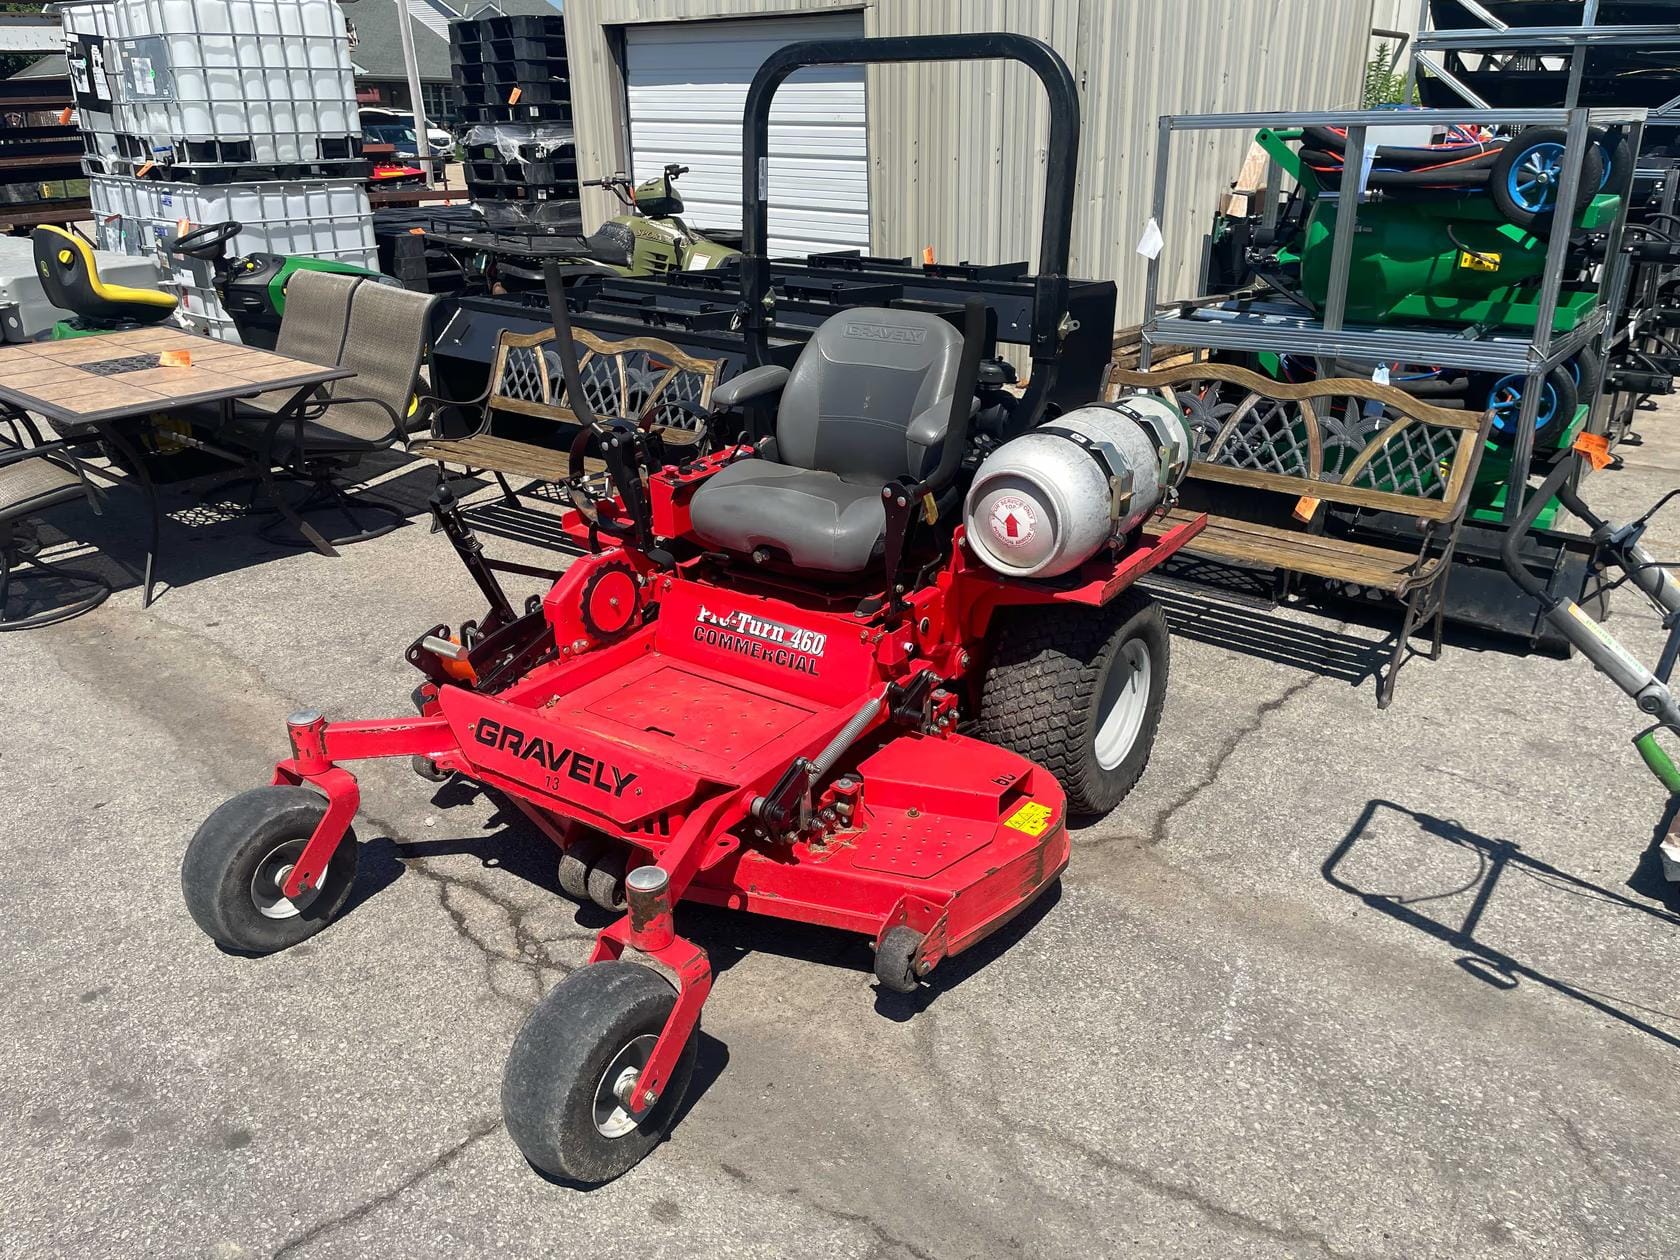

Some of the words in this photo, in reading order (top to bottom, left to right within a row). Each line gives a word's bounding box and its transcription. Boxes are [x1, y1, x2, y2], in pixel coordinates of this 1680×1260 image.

[847, 326, 924, 342] GRAVELY
[693, 626, 819, 676] COMMERCIAL
[790, 628, 825, 656] 460
[475, 717, 638, 798] GRAVELY
